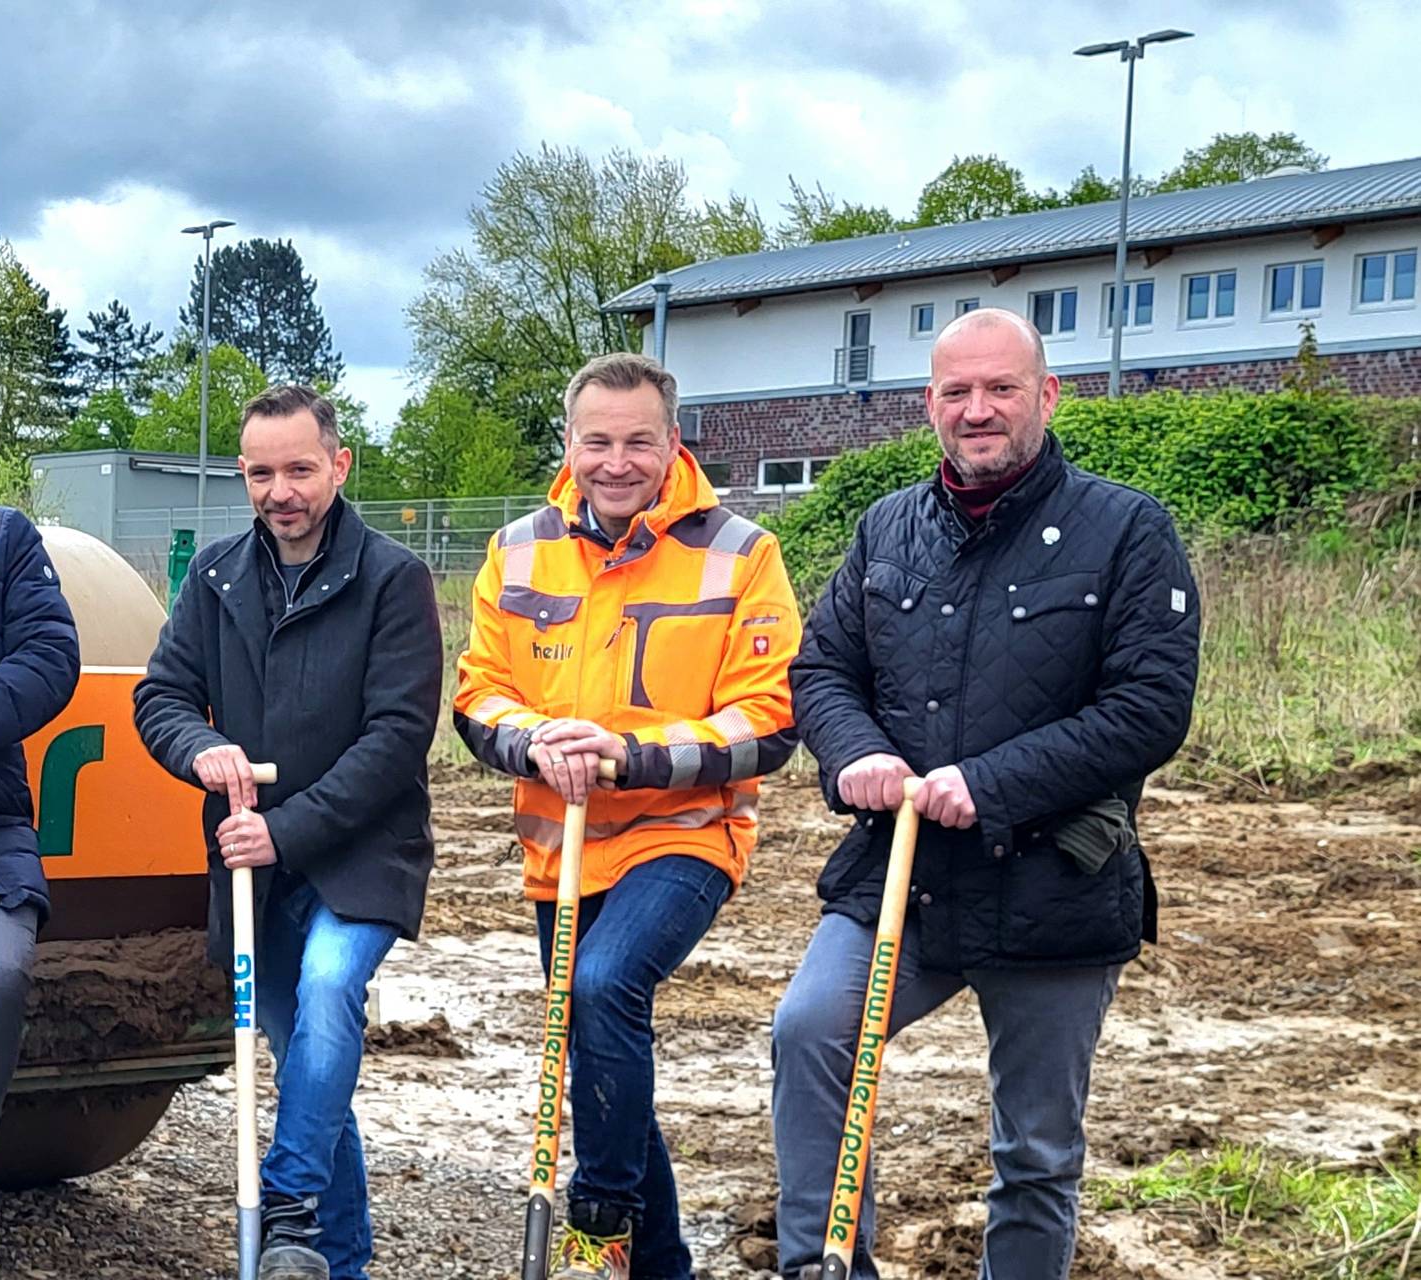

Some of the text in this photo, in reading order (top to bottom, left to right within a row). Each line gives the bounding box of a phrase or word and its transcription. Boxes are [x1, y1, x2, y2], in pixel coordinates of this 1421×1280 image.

[234, 953, 253, 1029] HEG
[533, 905, 574, 1184] www.heiler-sport.de
[829, 940, 895, 1243] www.heiler-sport.de
